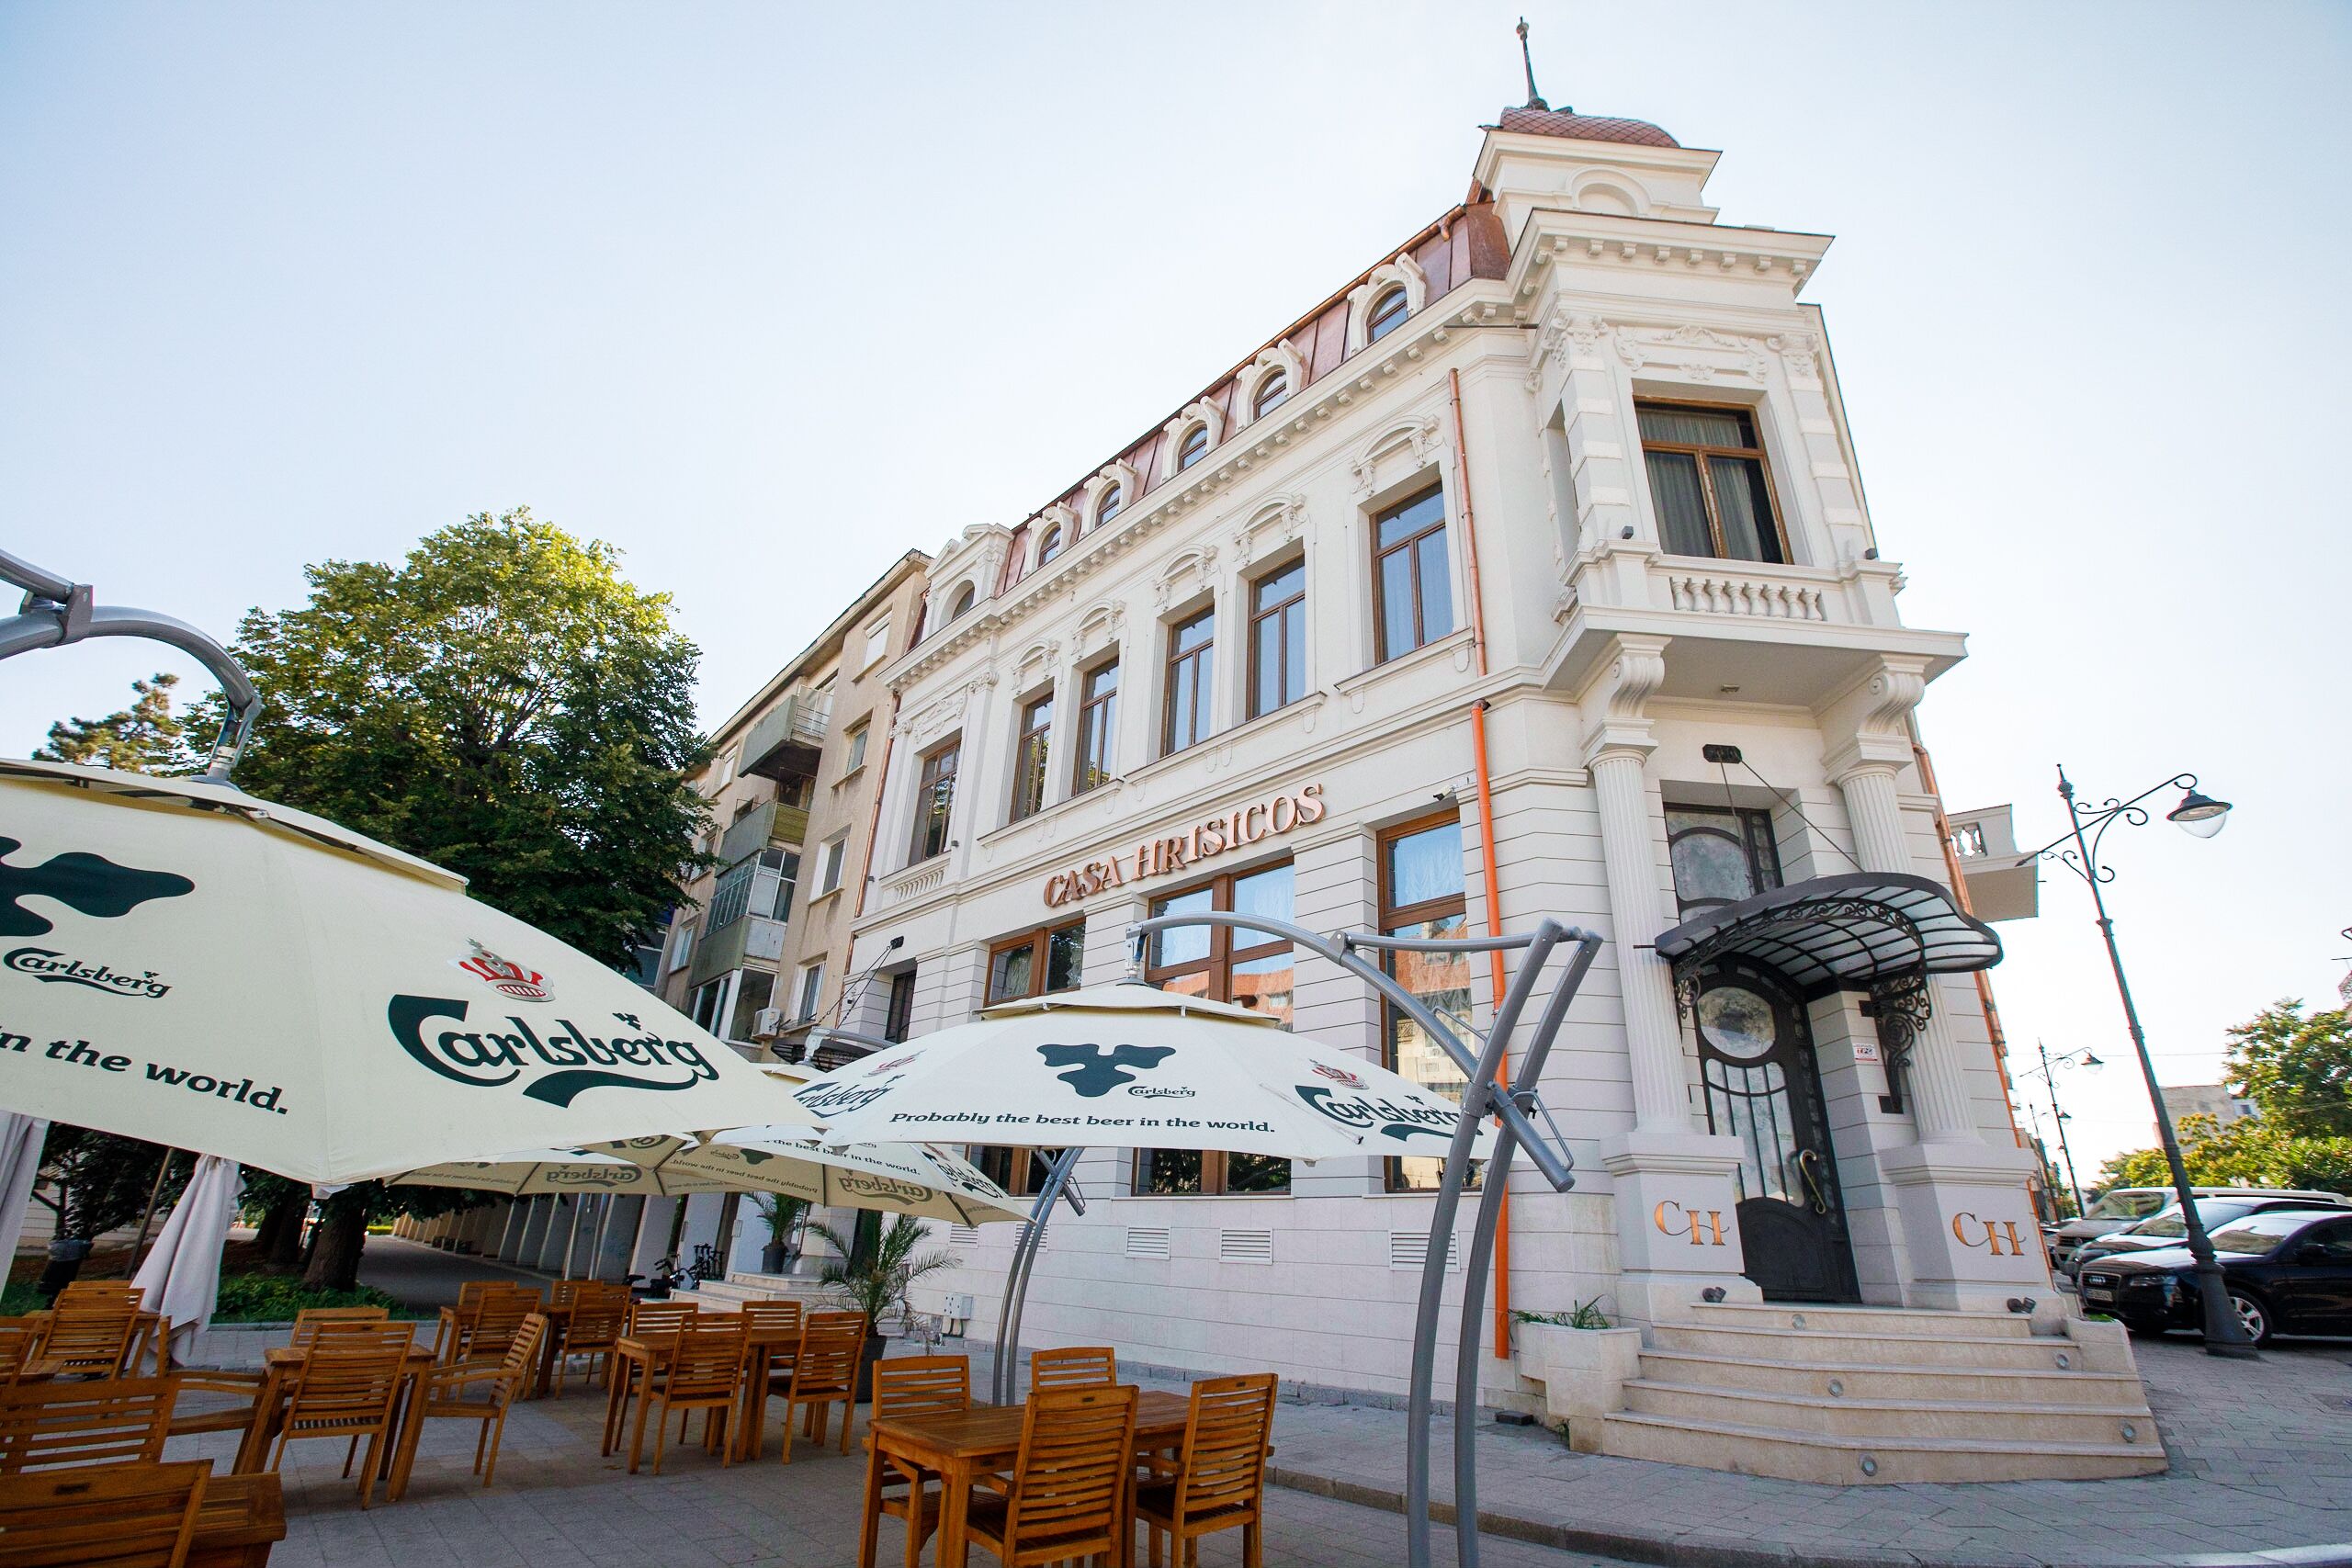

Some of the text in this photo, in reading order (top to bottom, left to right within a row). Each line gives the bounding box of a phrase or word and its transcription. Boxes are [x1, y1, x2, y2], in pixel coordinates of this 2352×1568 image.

[1044, 783, 1326, 908] CASA HRISICOS
[3, 947, 173, 998] Carlsberg
[0, 1026, 288, 1115] n the world.
[388, 993, 719, 1108] Carlsberg
[1127, 1087, 1196, 1100] Carlsberg
[889, 1112, 1275, 1133] Probably the best beer in the world.
[795, 1142, 820, 1153] best
[865, 1156, 883, 1166] the
[885, 1162, 921, 1176] world.
[1653, 1200, 1730, 1246] CH
[1951, 1212, 2027, 1257] CH
